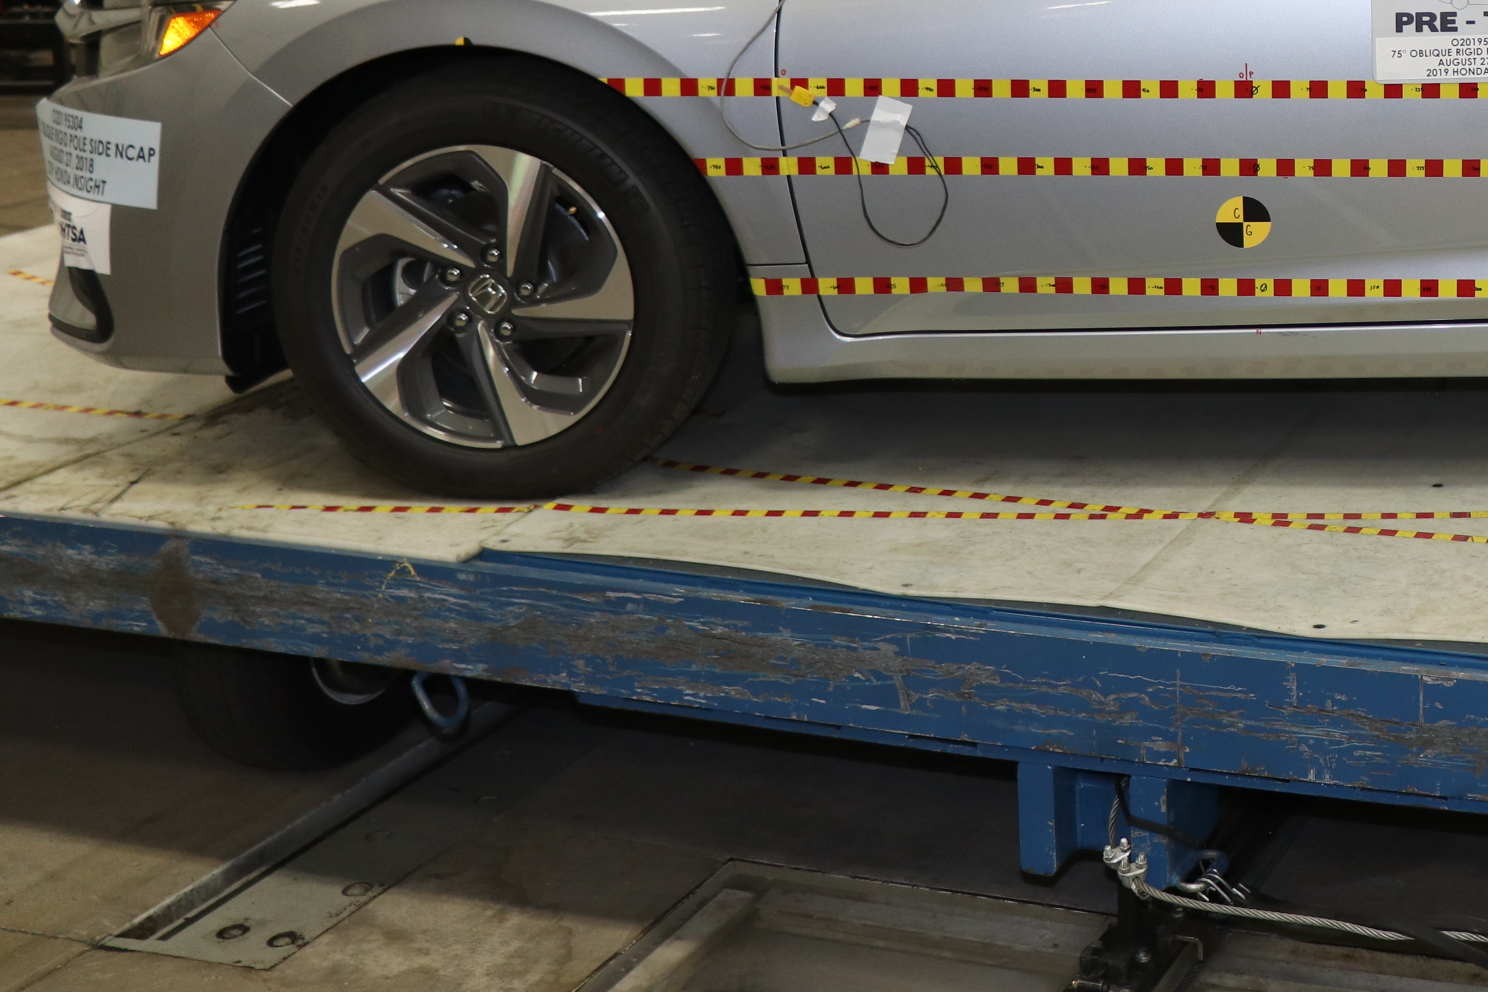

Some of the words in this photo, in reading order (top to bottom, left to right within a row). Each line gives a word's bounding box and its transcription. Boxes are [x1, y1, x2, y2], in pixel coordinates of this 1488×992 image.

[1395, 11, 1458, 33] PRE
[1410, 48, 1453, 58] OBLIQUE
[1455, 47, 1483, 56] RIGID
[1438, 58, 1476, 67] AUGUST
[1426, 69, 1449, 77] 2019
[89, 138, 112, 158] SIDE
[114, 142, 157, 164] NCAP
[1233, 207, 1241, 220] C
[58, 220, 88, 246] HTSA
[1245, 224, 1253, 237] G
